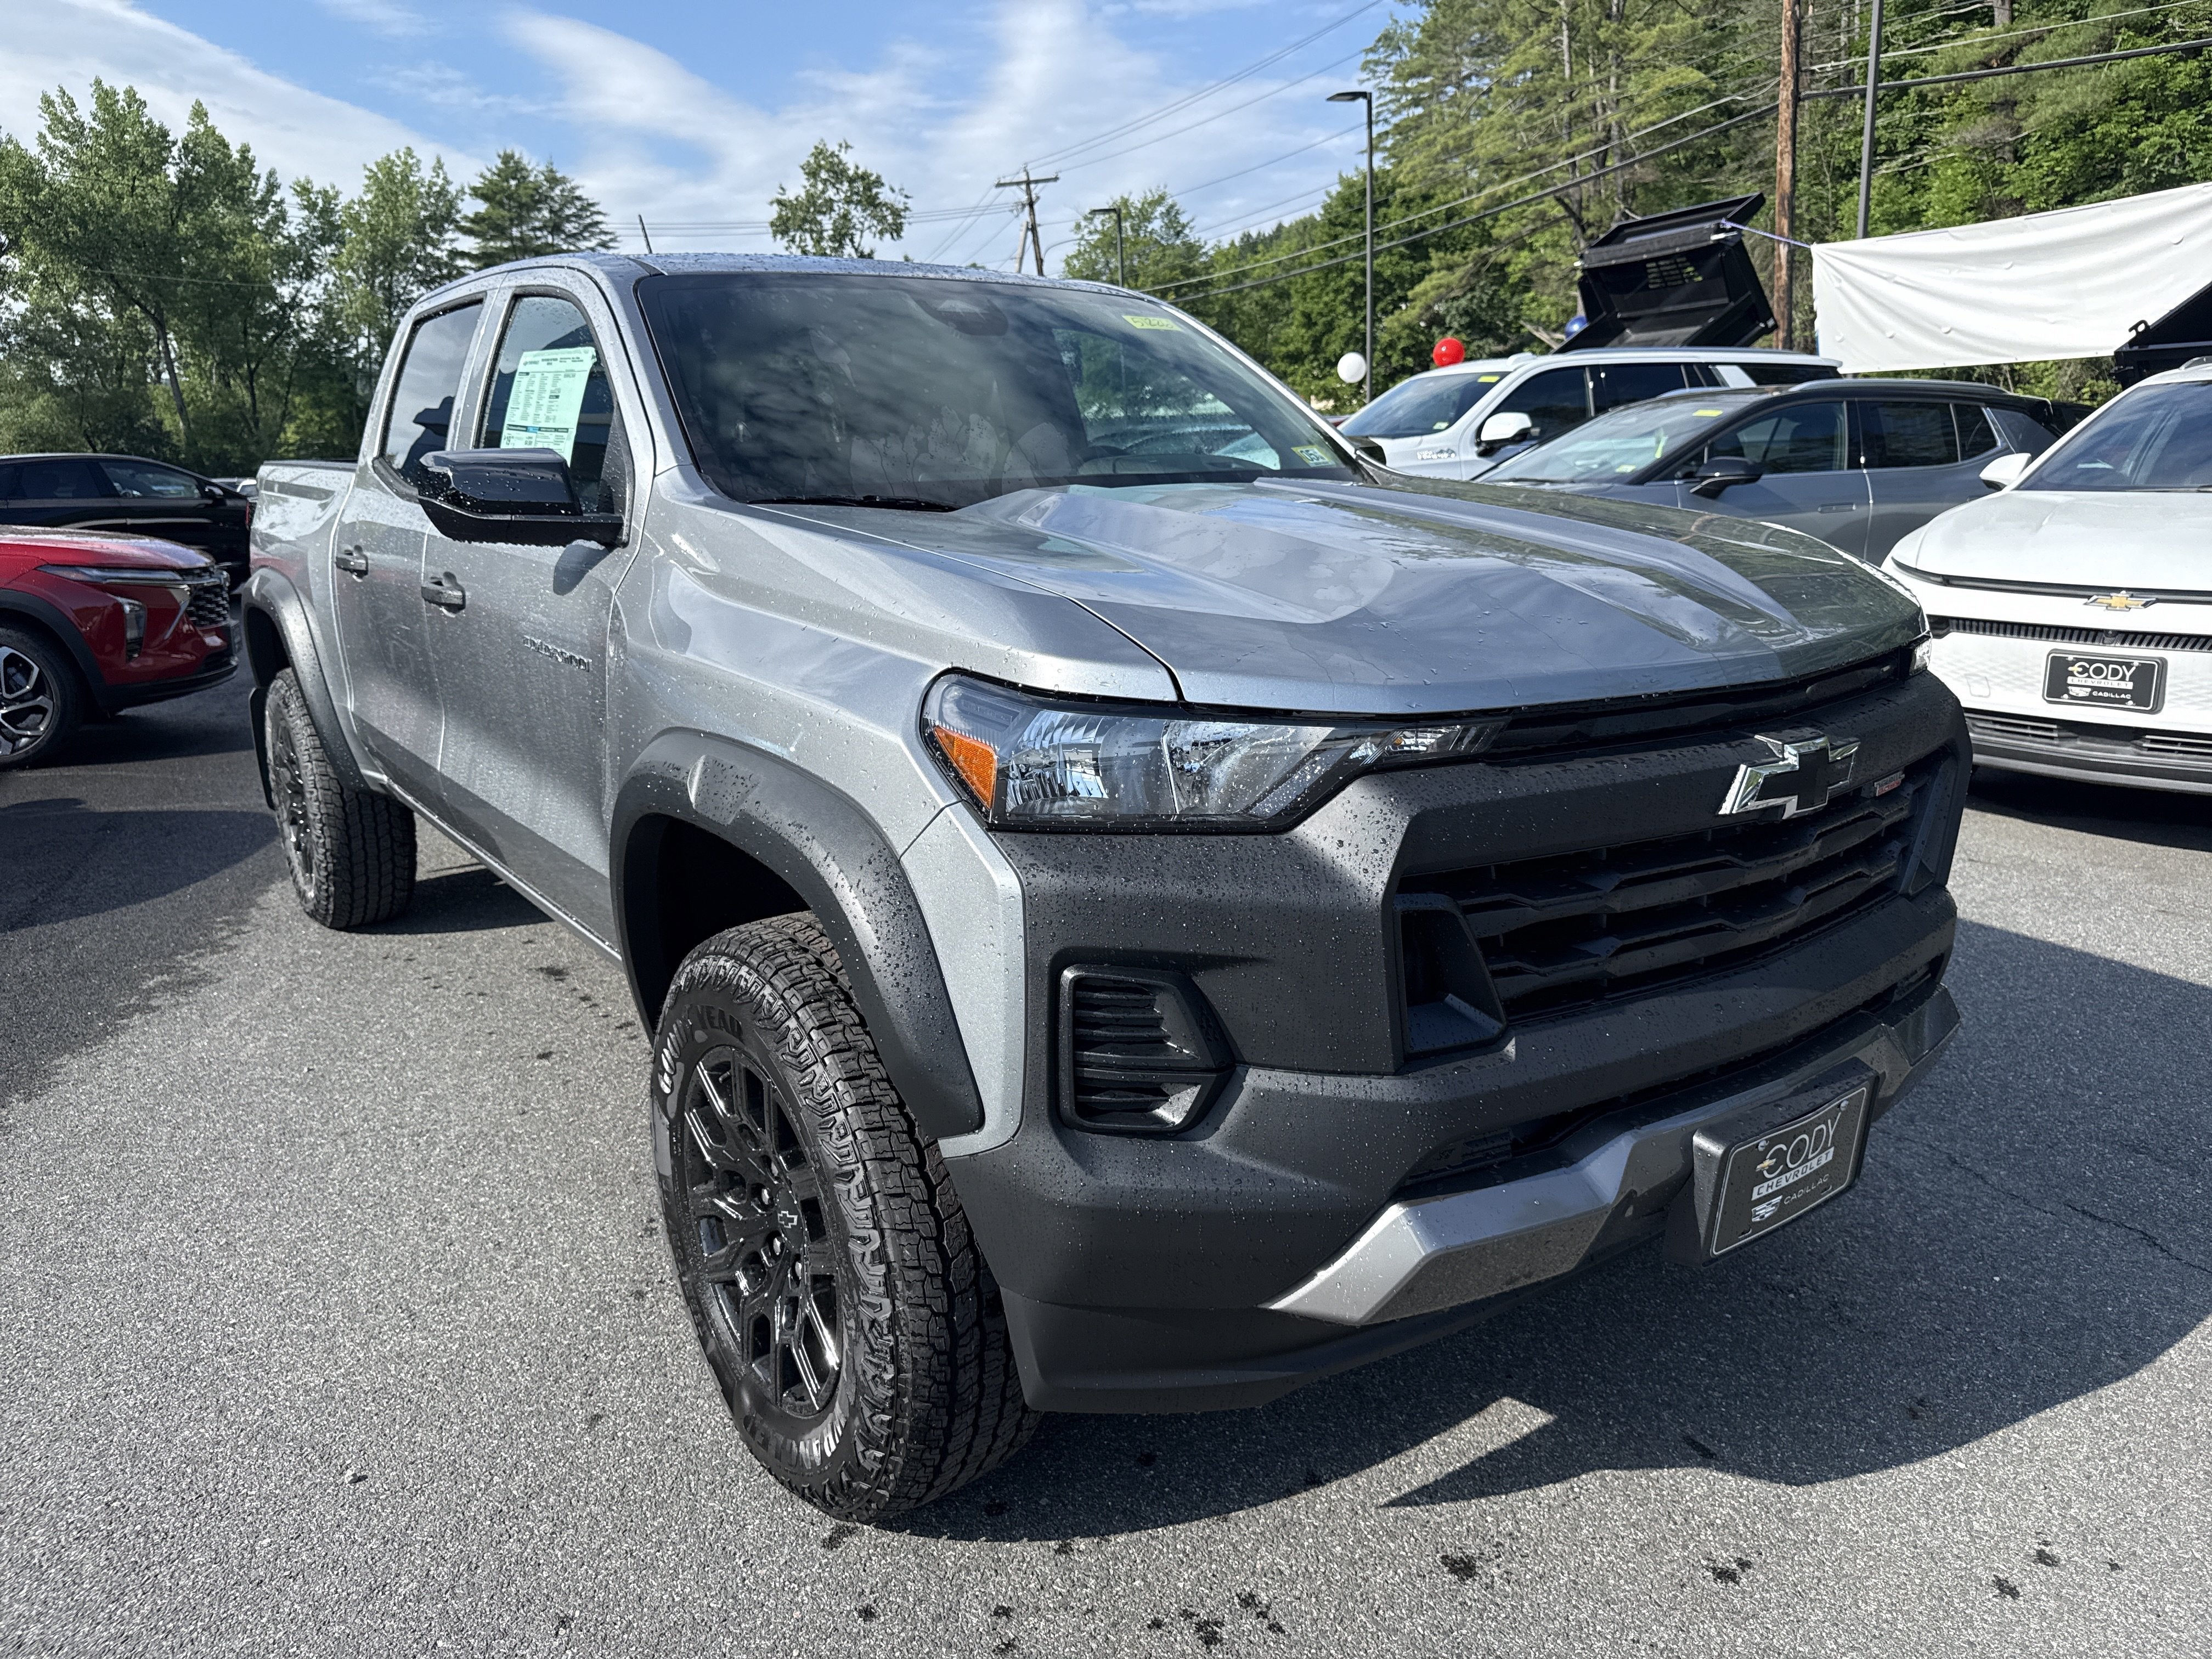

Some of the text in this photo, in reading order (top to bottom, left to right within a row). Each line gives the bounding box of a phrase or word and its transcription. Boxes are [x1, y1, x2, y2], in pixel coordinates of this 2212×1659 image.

[2071, 679, 2129, 687] CHEVROLET
[2074, 662, 2136, 681] CODY
[2093, 691, 2132, 699] CADILLAC
[1763, 1113, 1842, 1178] CODY
[1757, 1152, 1831, 1195] CHEVROLET
[1784, 1174, 1829, 1204] CADILLAC
